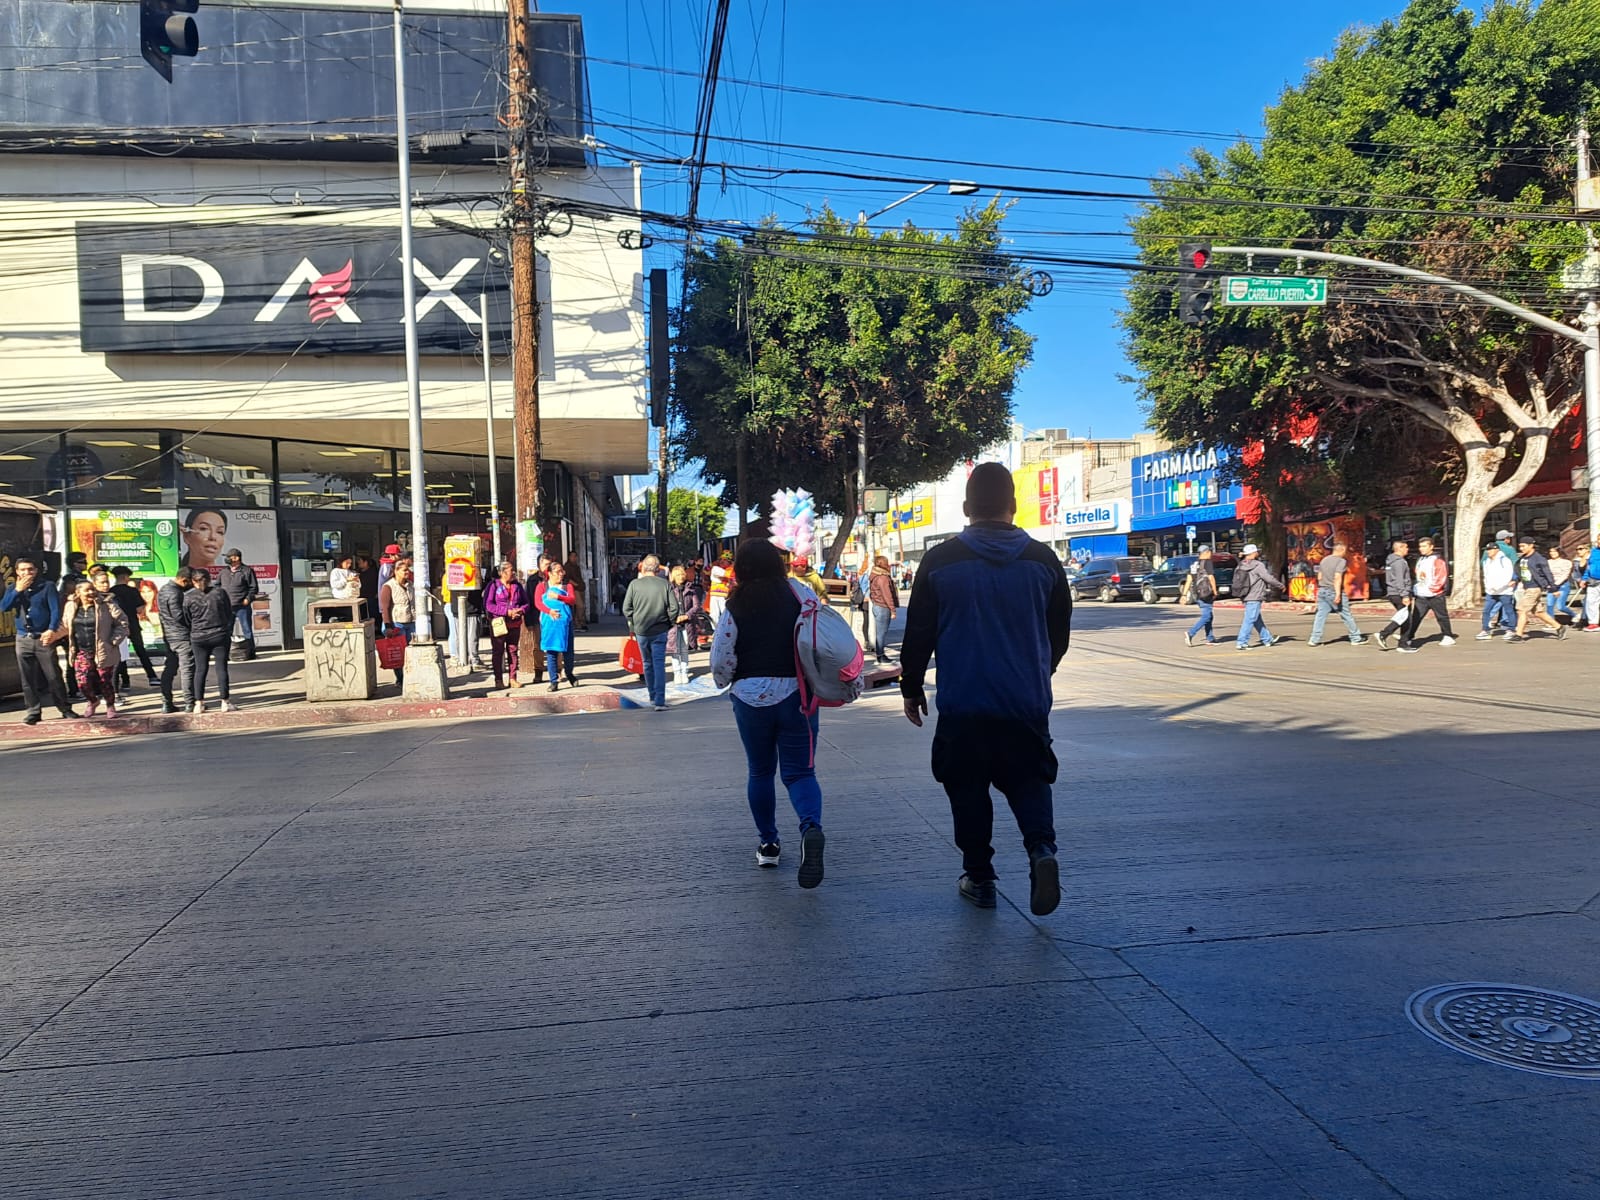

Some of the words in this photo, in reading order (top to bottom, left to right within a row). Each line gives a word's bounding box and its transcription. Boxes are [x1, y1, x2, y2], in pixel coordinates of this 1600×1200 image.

[120, 253, 482, 323] DAX
[1247, 288, 1279, 301] CARRILLO
[1280, 288, 1305, 301] PUERTO
[1143, 446, 1218, 483] FARMACIA
[99, 510, 149, 520] GARNIER
[1065, 507, 1111, 525] Estrella
